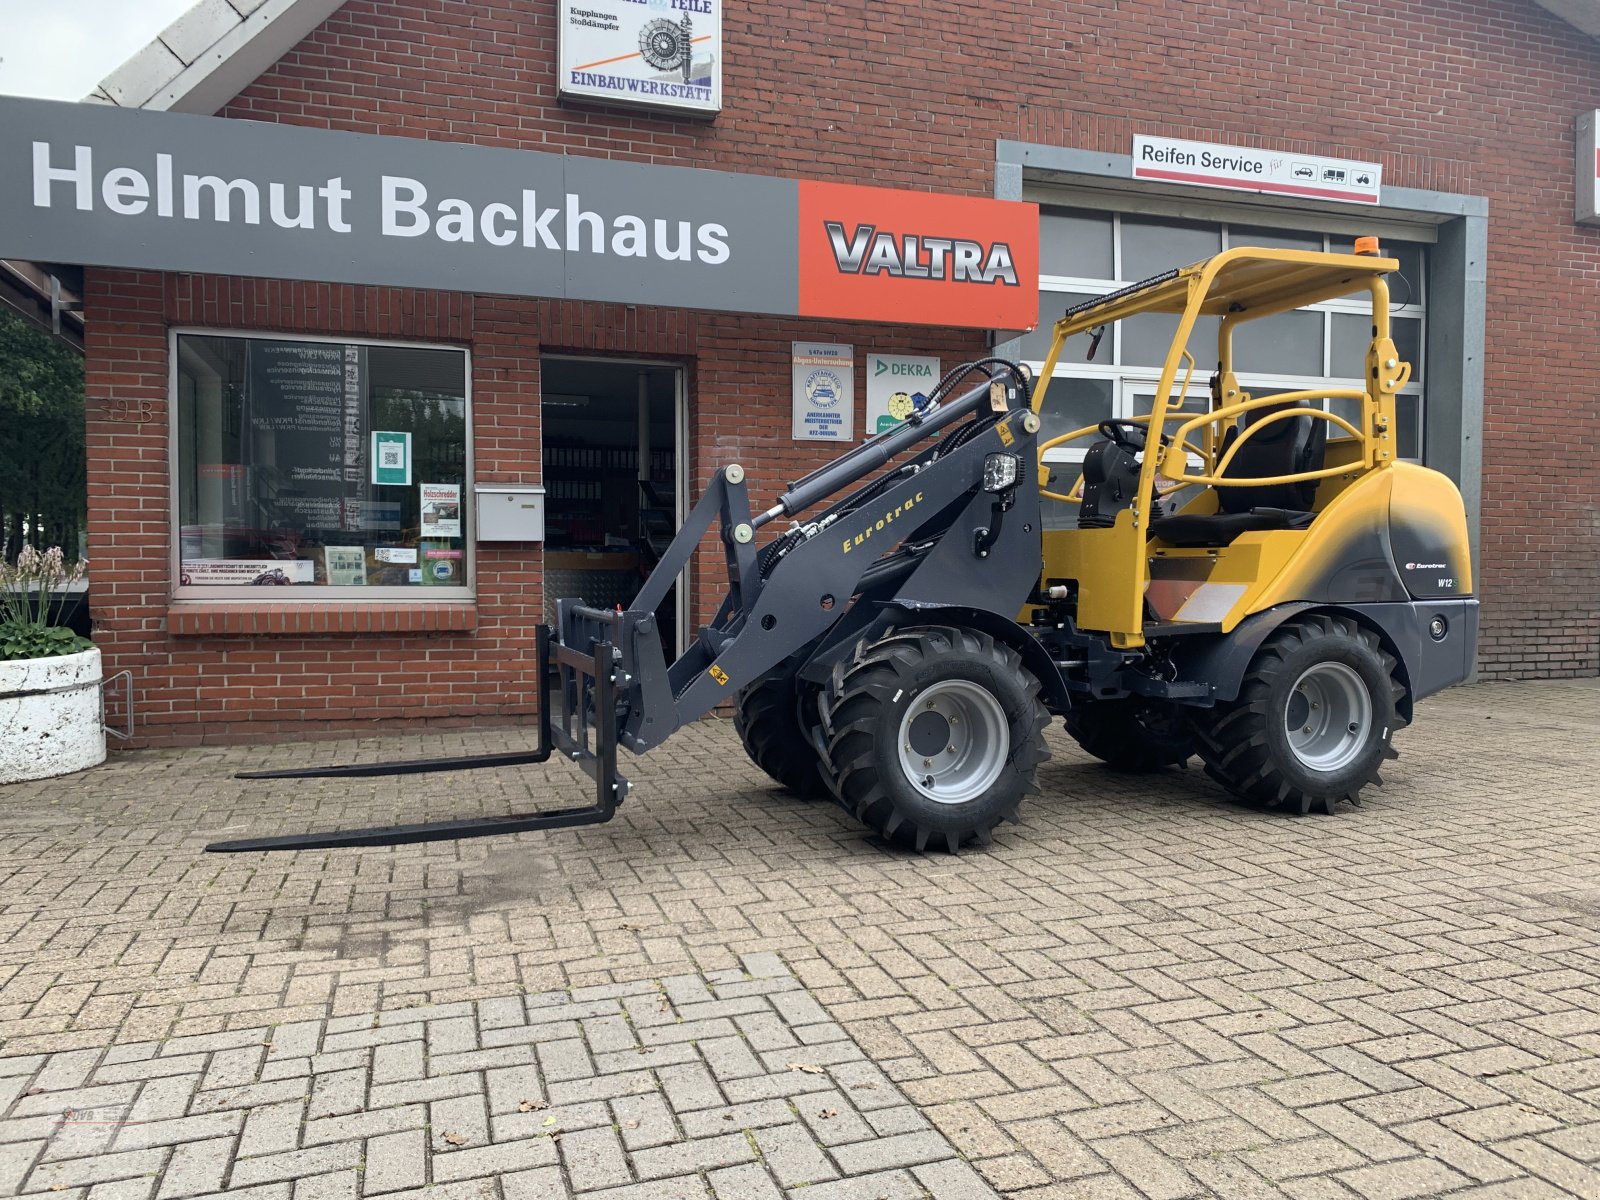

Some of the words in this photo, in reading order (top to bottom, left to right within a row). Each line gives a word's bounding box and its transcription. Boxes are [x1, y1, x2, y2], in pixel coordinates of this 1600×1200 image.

[570, 7, 618, 21] Kupplungen
[671, 0, 712, 14] TEILE
[570, 17, 620, 31] Stoßdämpfer
[571, 71, 712, 101] EINBAUWERKSTATT
[1142, 144, 1196, 166] Reifen
[1201, 151, 1263, 174] Service
[1269, 158, 1284, 175] für
[32, 141, 352, 233] Helmut
[381, 175, 730, 265] Backhaus
[823, 220, 1021, 287] VALTRA
[793, 356, 853, 367] Abgas-Untersuchung
[891, 363, 932, 377] DEKRA
[423, 490, 458, 498] Holzschredder
[843, 491, 923, 554] Eurotrac
